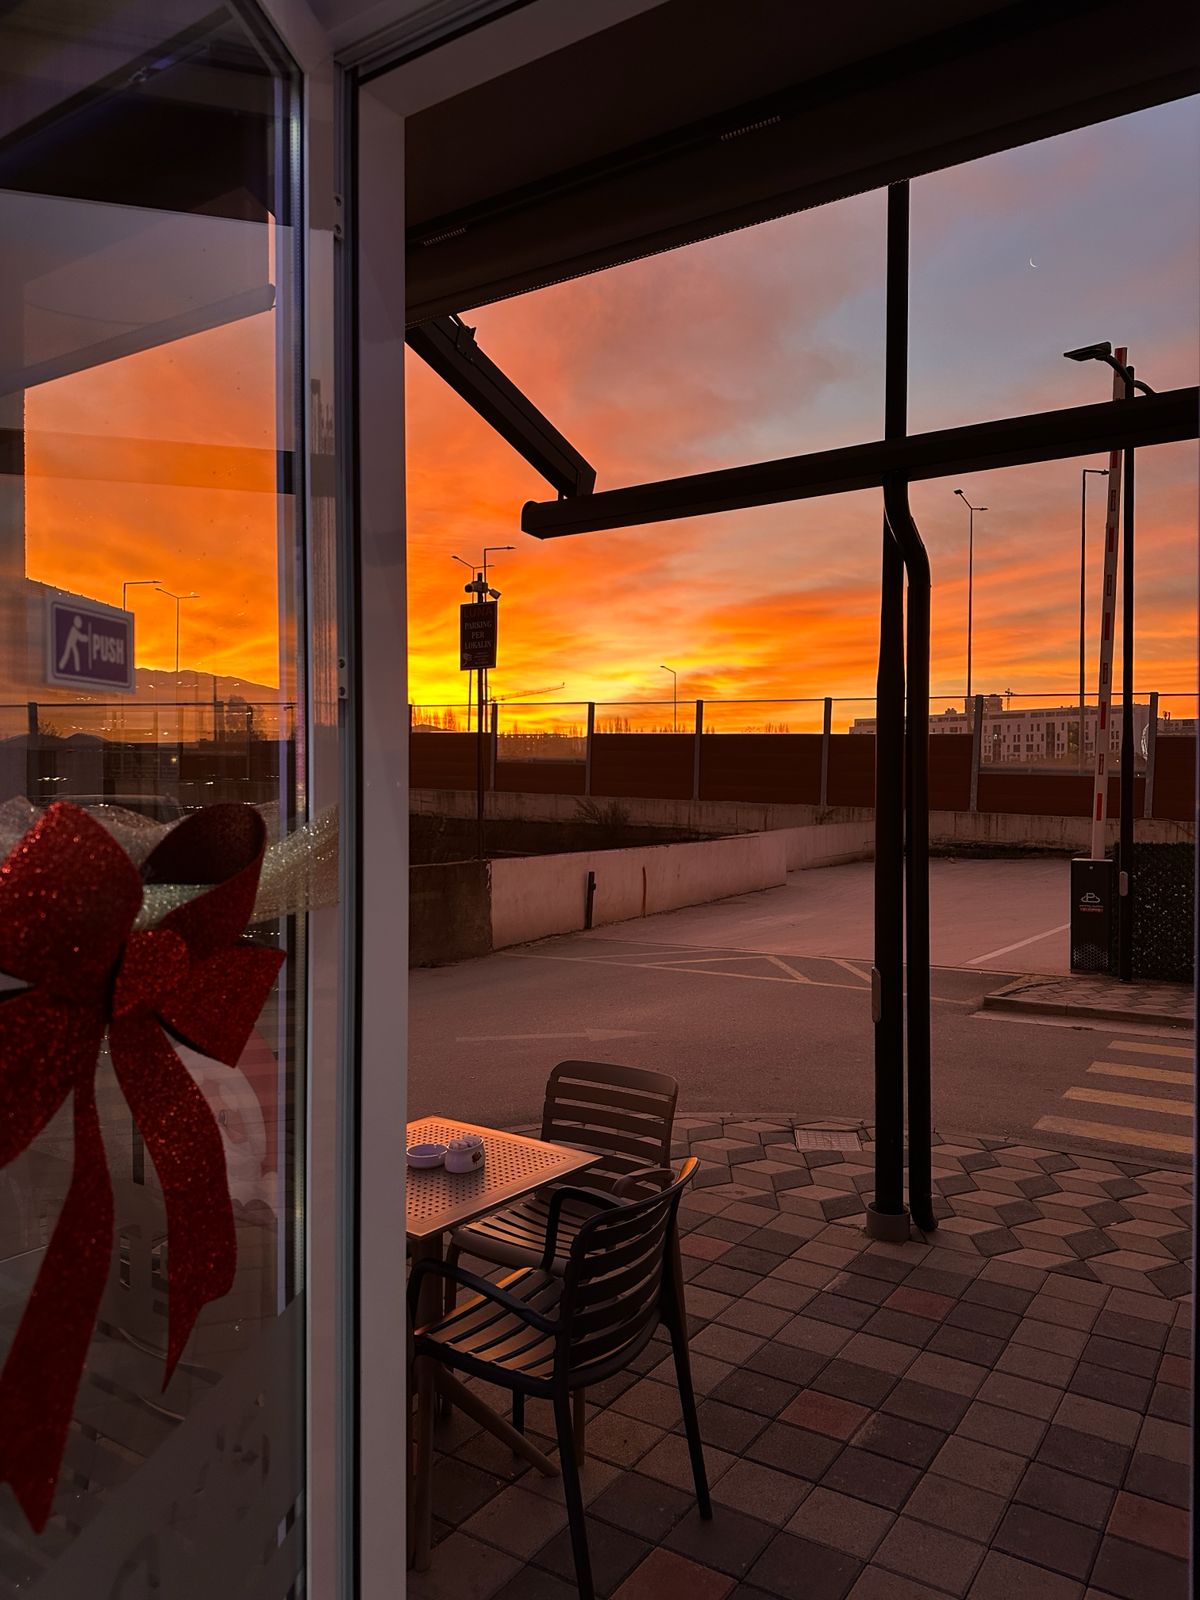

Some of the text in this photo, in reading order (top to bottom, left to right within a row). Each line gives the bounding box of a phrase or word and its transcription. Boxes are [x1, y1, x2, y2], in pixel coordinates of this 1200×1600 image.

[464, 621, 492, 630] PARKING
[471, 631, 485, 639] PER
[93, 633, 125, 664] PUSH
